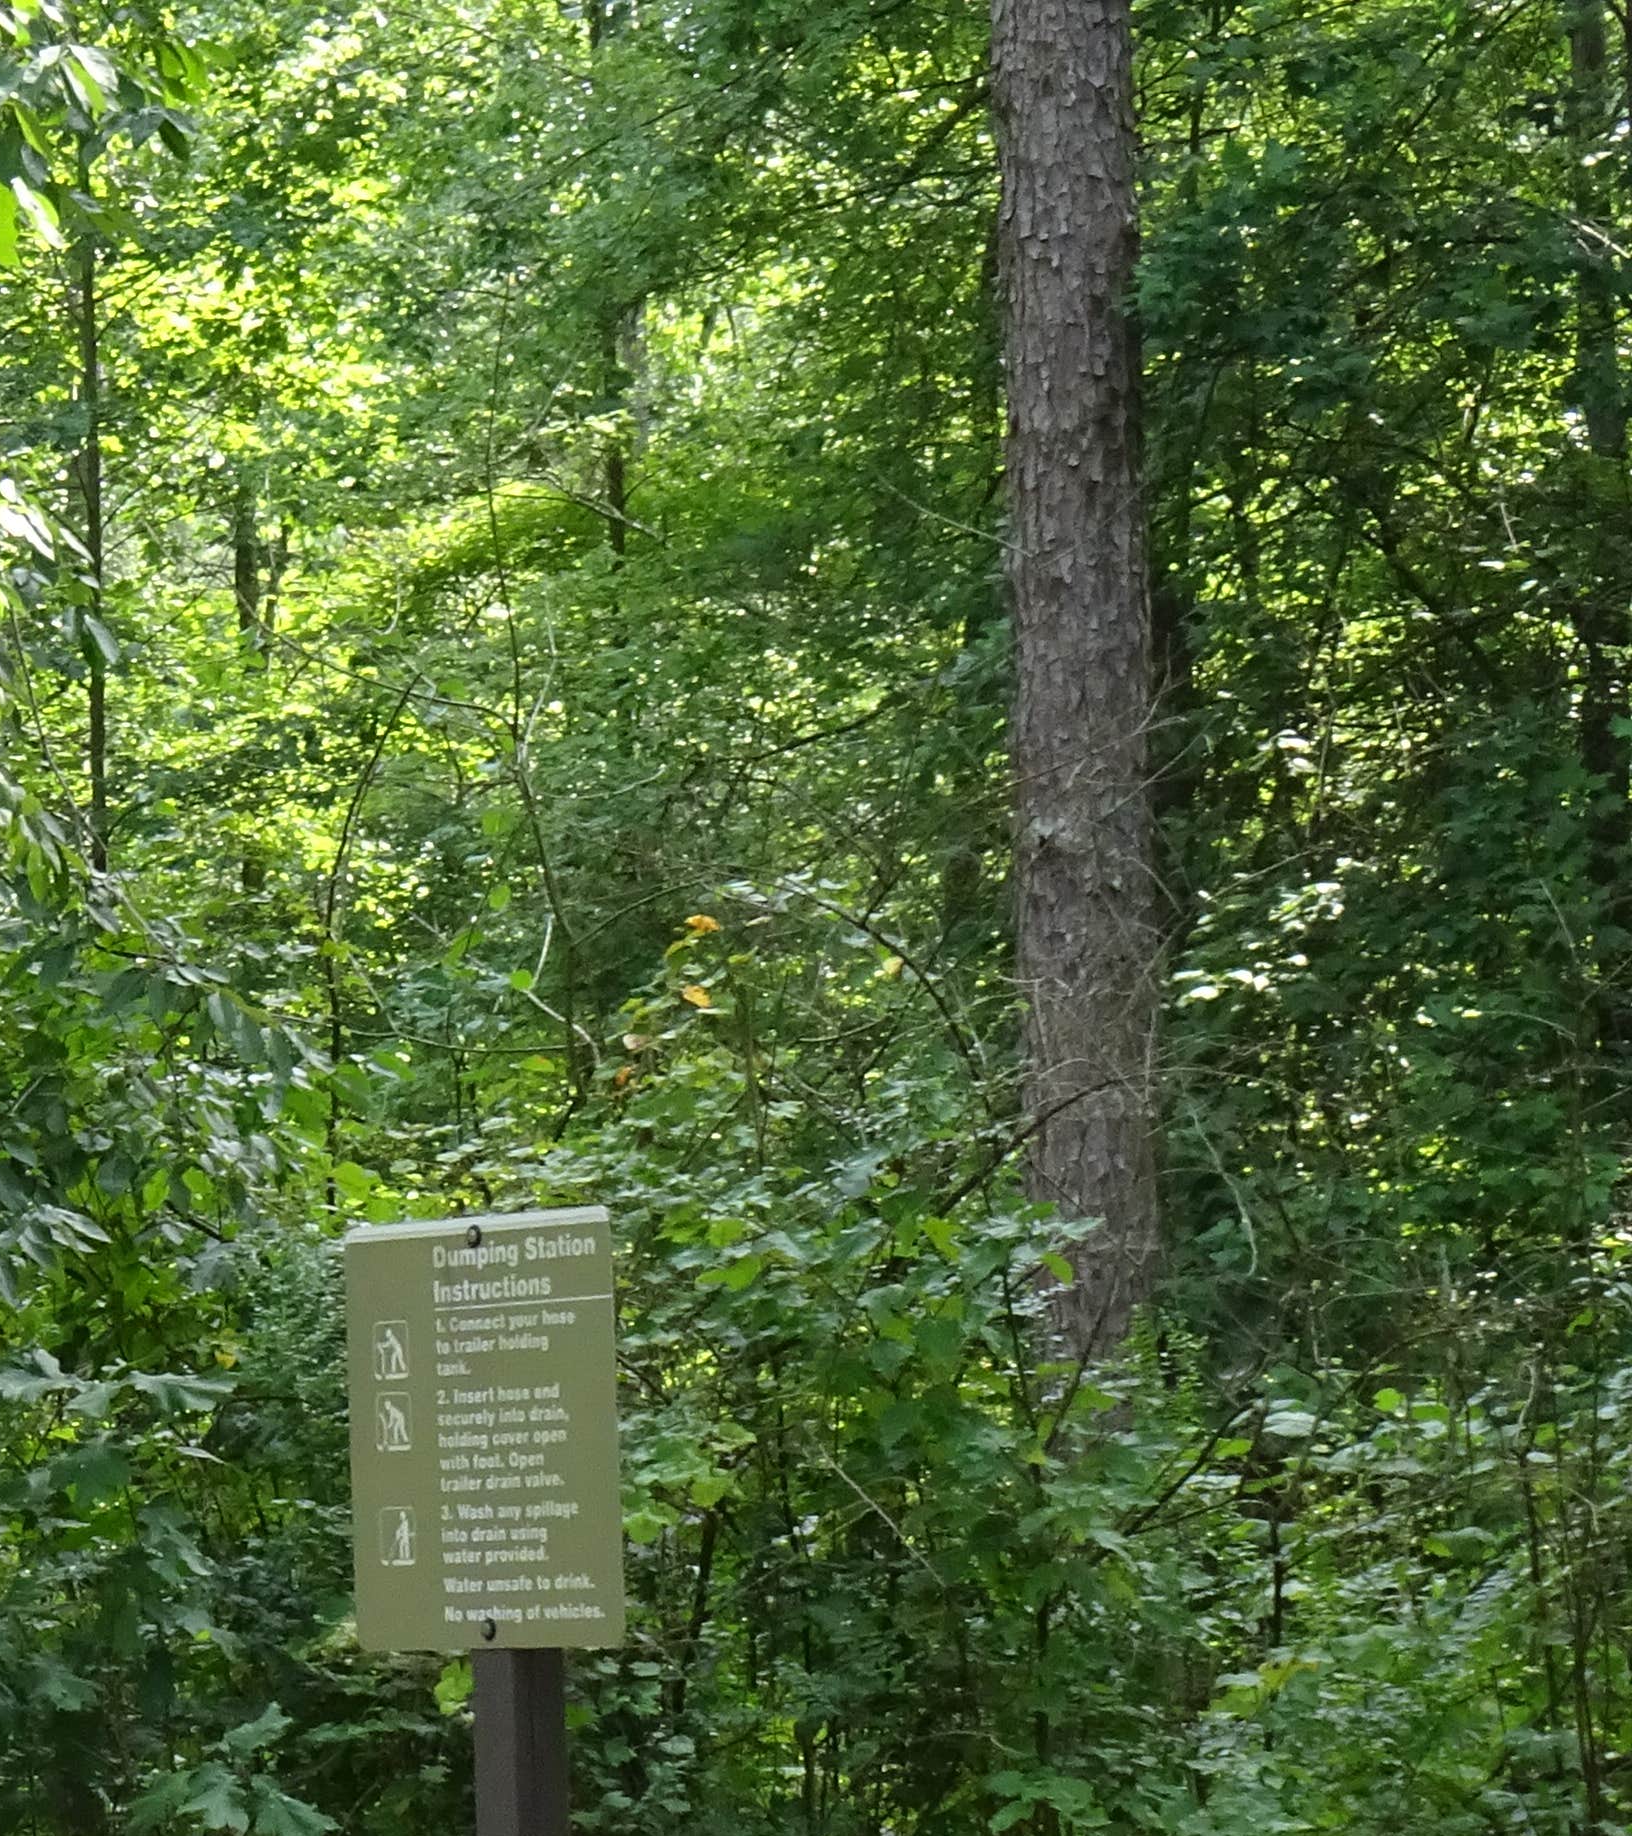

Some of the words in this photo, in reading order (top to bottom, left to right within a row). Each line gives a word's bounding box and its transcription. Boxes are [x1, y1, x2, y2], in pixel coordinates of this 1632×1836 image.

[524, 1233, 596, 1261] Station
[433, 1273, 551, 1302] Instructions
[454, 1337, 496, 1353] trailer
[498, 1333, 549, 1351] holding
[453, 1387, 494, 1404] Insert
[437, 1408, 495, 1427] securely
[499, 1407, 526, 1423] into
[438, 1431, 488, 1449] holding
[492, 1431, 529, 1446] cover
[533, 1429, 567, 1447] open
[440, 1455, 470, 1471] with
[509, 1451, 545, 1470] Open
[440, 1476, 482, 1492] trailer
[485, 1473, 521, 1490] drain
[457, 1503, 494, 1519] Wash
[497, 1505, 522, 1521] any
[441, 1526, 468, 1543] into
[471, 1525, 507, 1542] drain
[442, 1549, 482, 1564] water
[443, 1577, 483, 1593] Water
[537, 1575, 551, 1590] to
[444, 1606, 464, 1622] No
